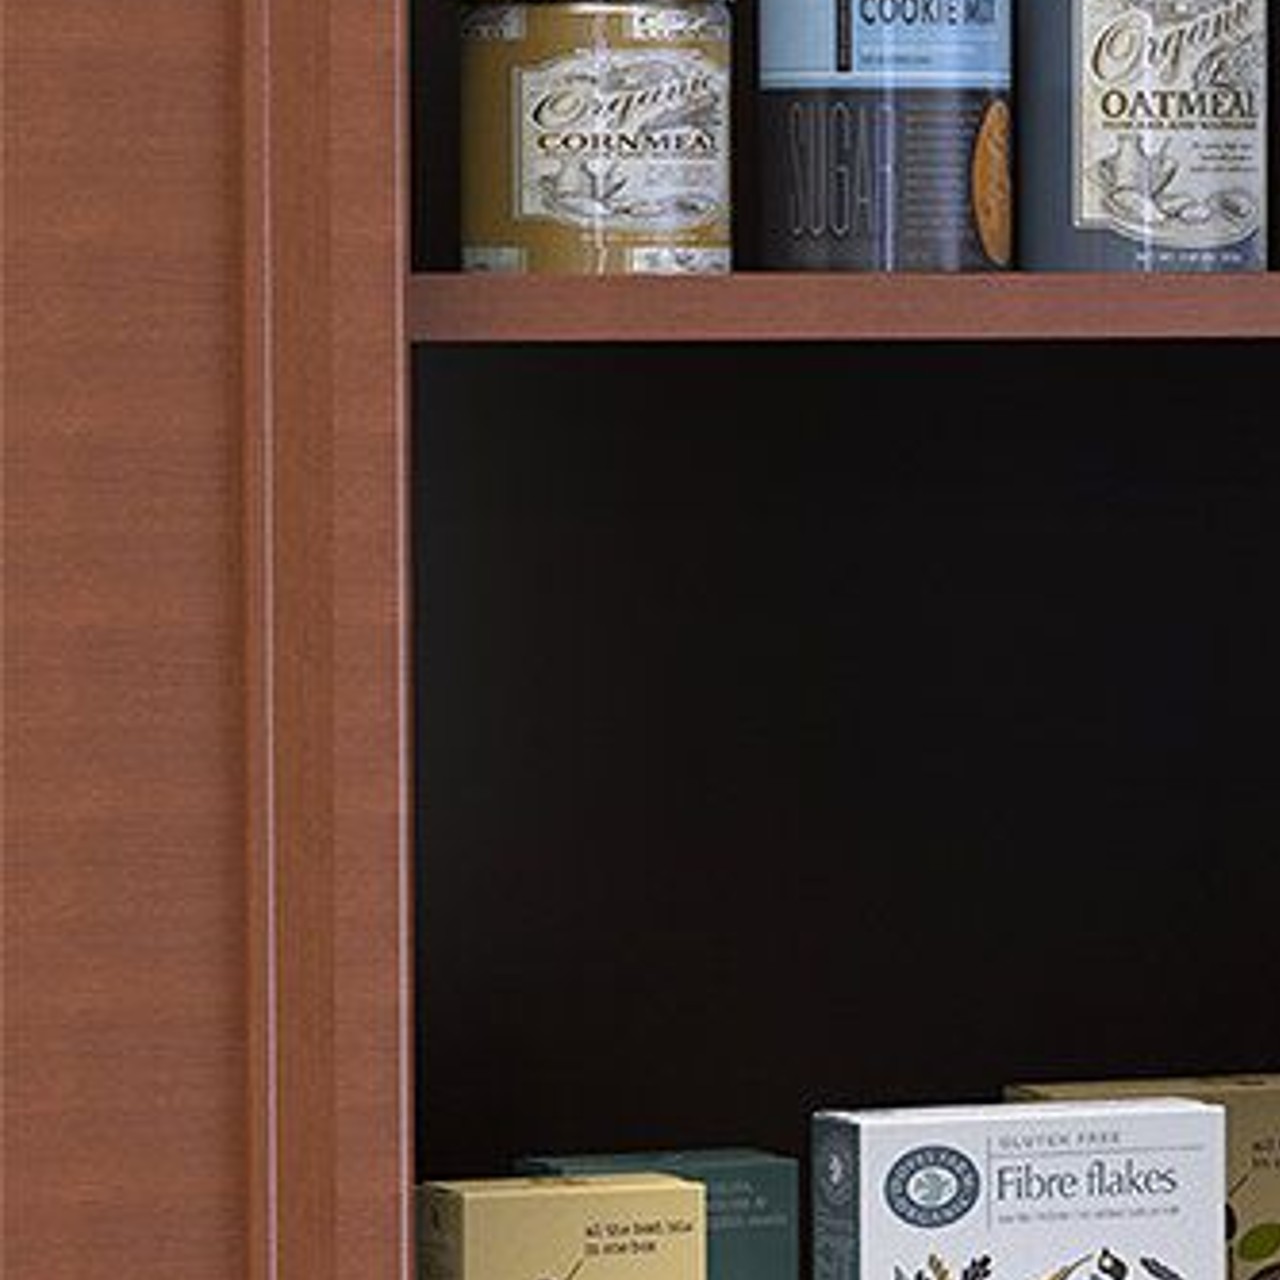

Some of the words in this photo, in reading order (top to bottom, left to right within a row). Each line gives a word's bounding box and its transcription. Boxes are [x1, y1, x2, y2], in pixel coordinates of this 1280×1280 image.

[1101, 89, 1259, 120] OATMEAL
[996, 1162, 1080, 1201] Fibre
[1085, 1157, 1180, 1198] flakes
